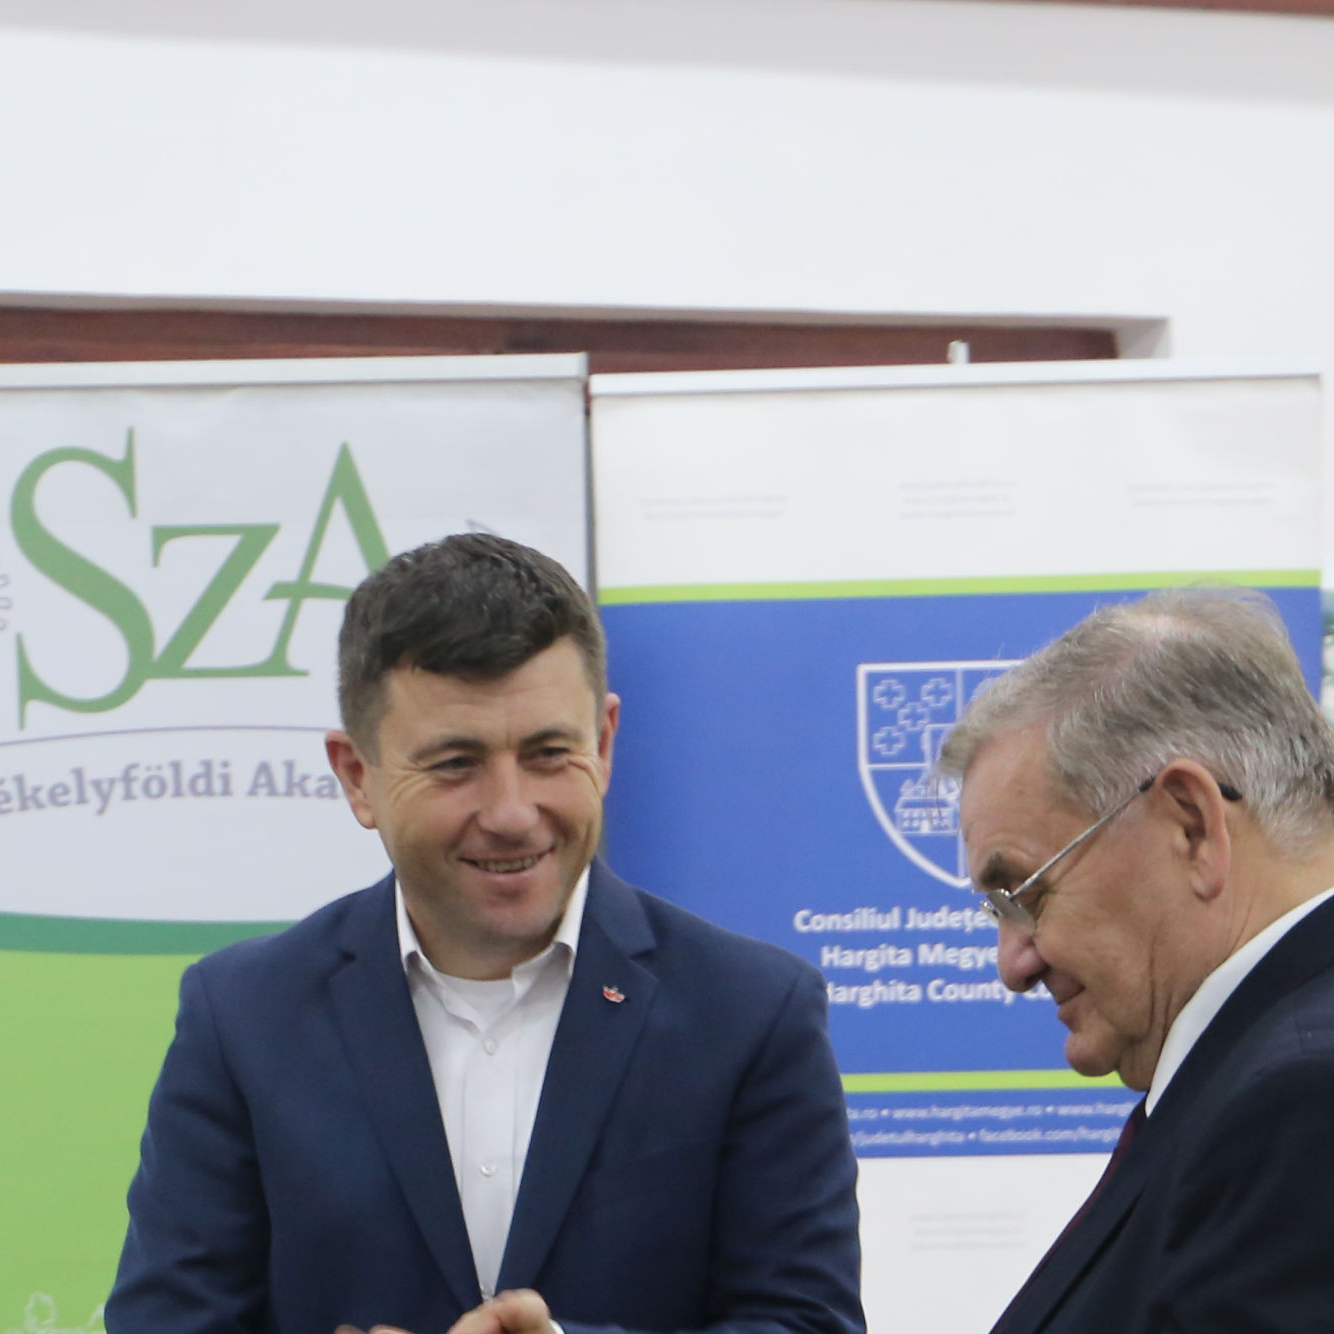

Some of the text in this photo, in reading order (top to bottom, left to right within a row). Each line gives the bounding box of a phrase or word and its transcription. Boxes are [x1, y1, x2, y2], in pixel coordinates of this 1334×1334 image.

[10, 426, 391, 731] SzA
[794, 906, 901, 932] Consiliul
[821, 943, 913, 972] Hargita
